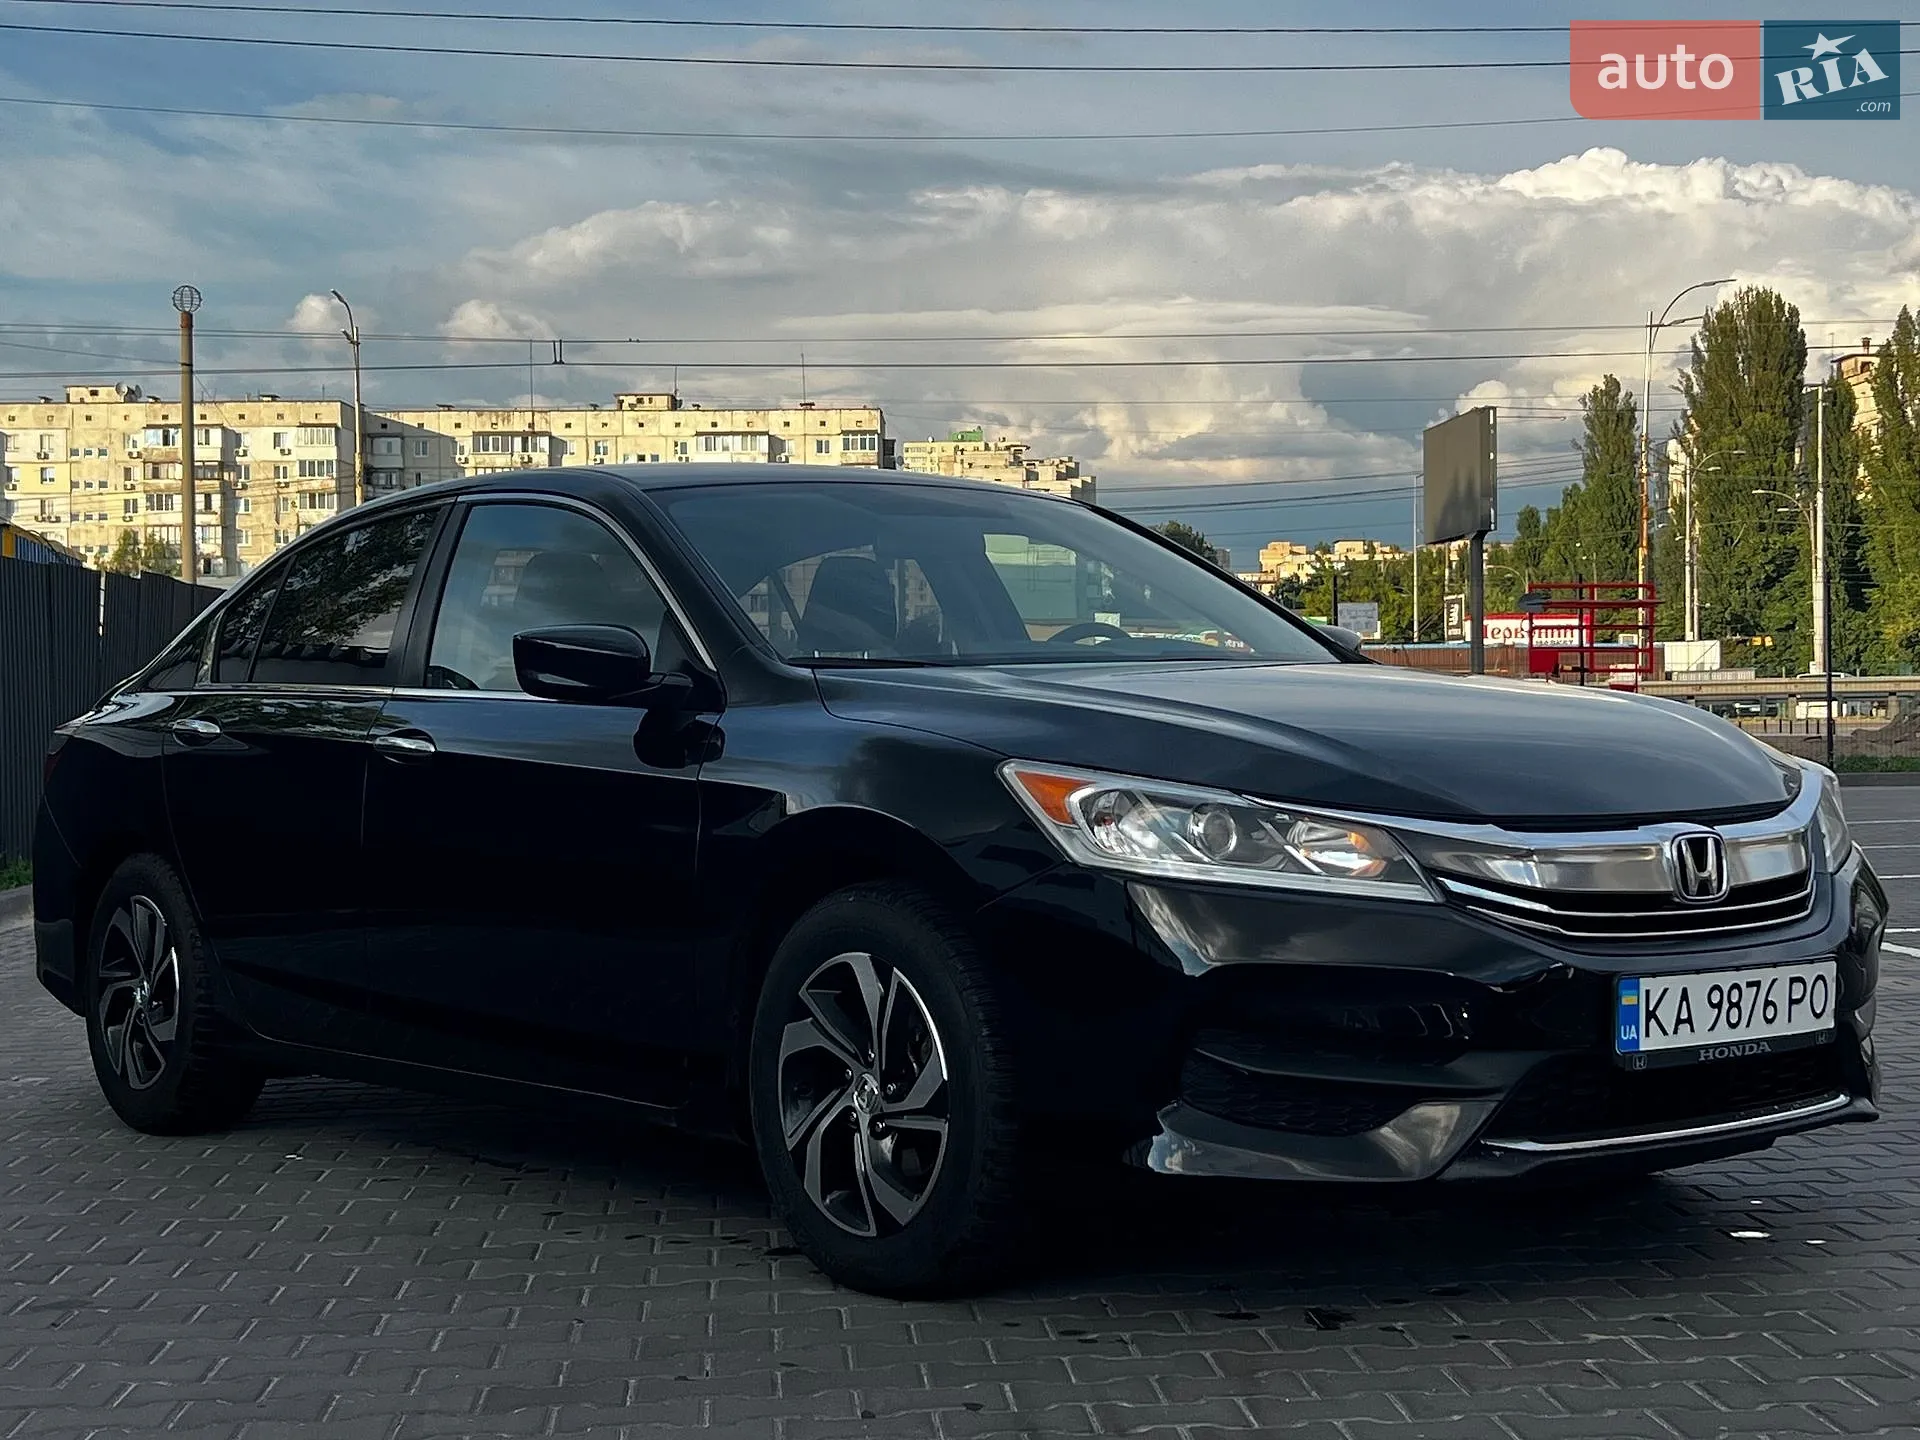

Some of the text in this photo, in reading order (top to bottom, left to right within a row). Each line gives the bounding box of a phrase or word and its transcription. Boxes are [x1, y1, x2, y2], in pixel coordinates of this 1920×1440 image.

[1644, 973, 1828, 1038] KA 9876 PO
[1621, 1025, 1638, 1040] UA
[1698, 1041, 1772, 1061] HONDA
